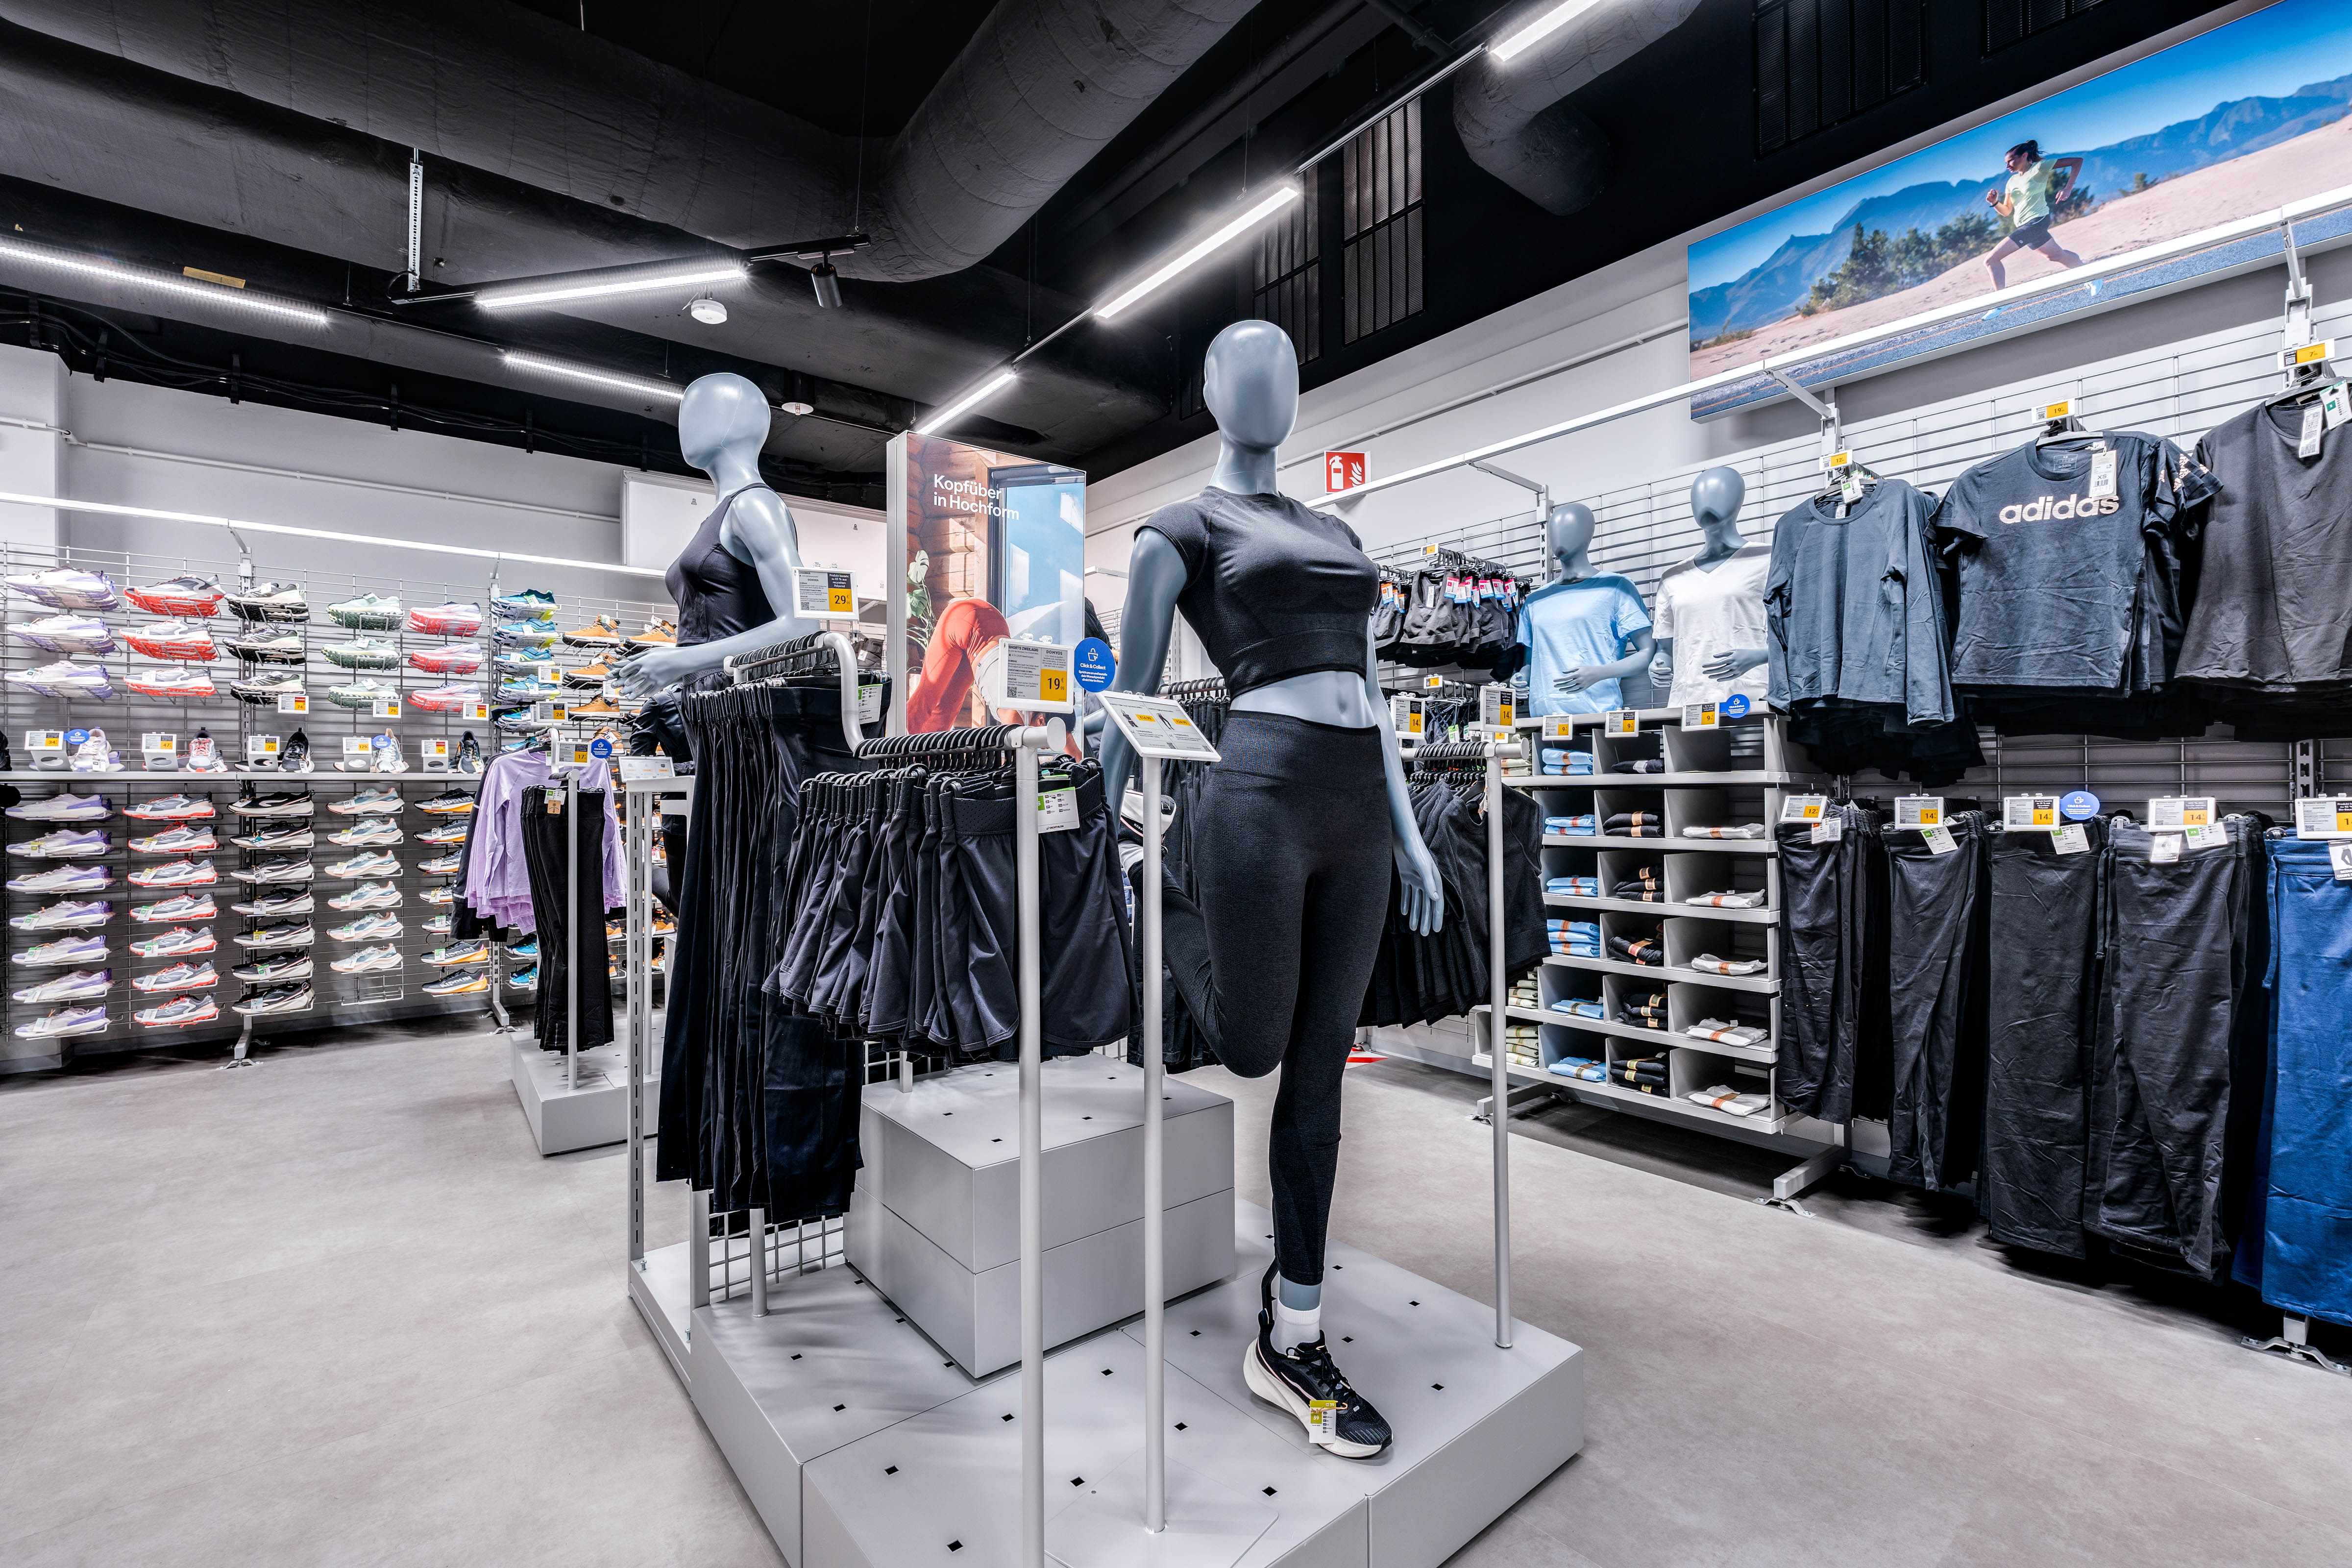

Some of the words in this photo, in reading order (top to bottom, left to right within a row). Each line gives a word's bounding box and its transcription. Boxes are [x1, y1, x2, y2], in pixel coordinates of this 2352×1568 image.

[934, 474, 1002, 499] Kopfüber
[934, 492, 947, 507] in
[950, 494, 1019, 520] Hochform
[1999, 494, 2119, 524] adidas
[834, 595, 846, 604] 29
[1048, 678, 1060, 690] 19
[442, 826, 468, 835] IPRU
[444, 946, 475, 958] IPRUN
